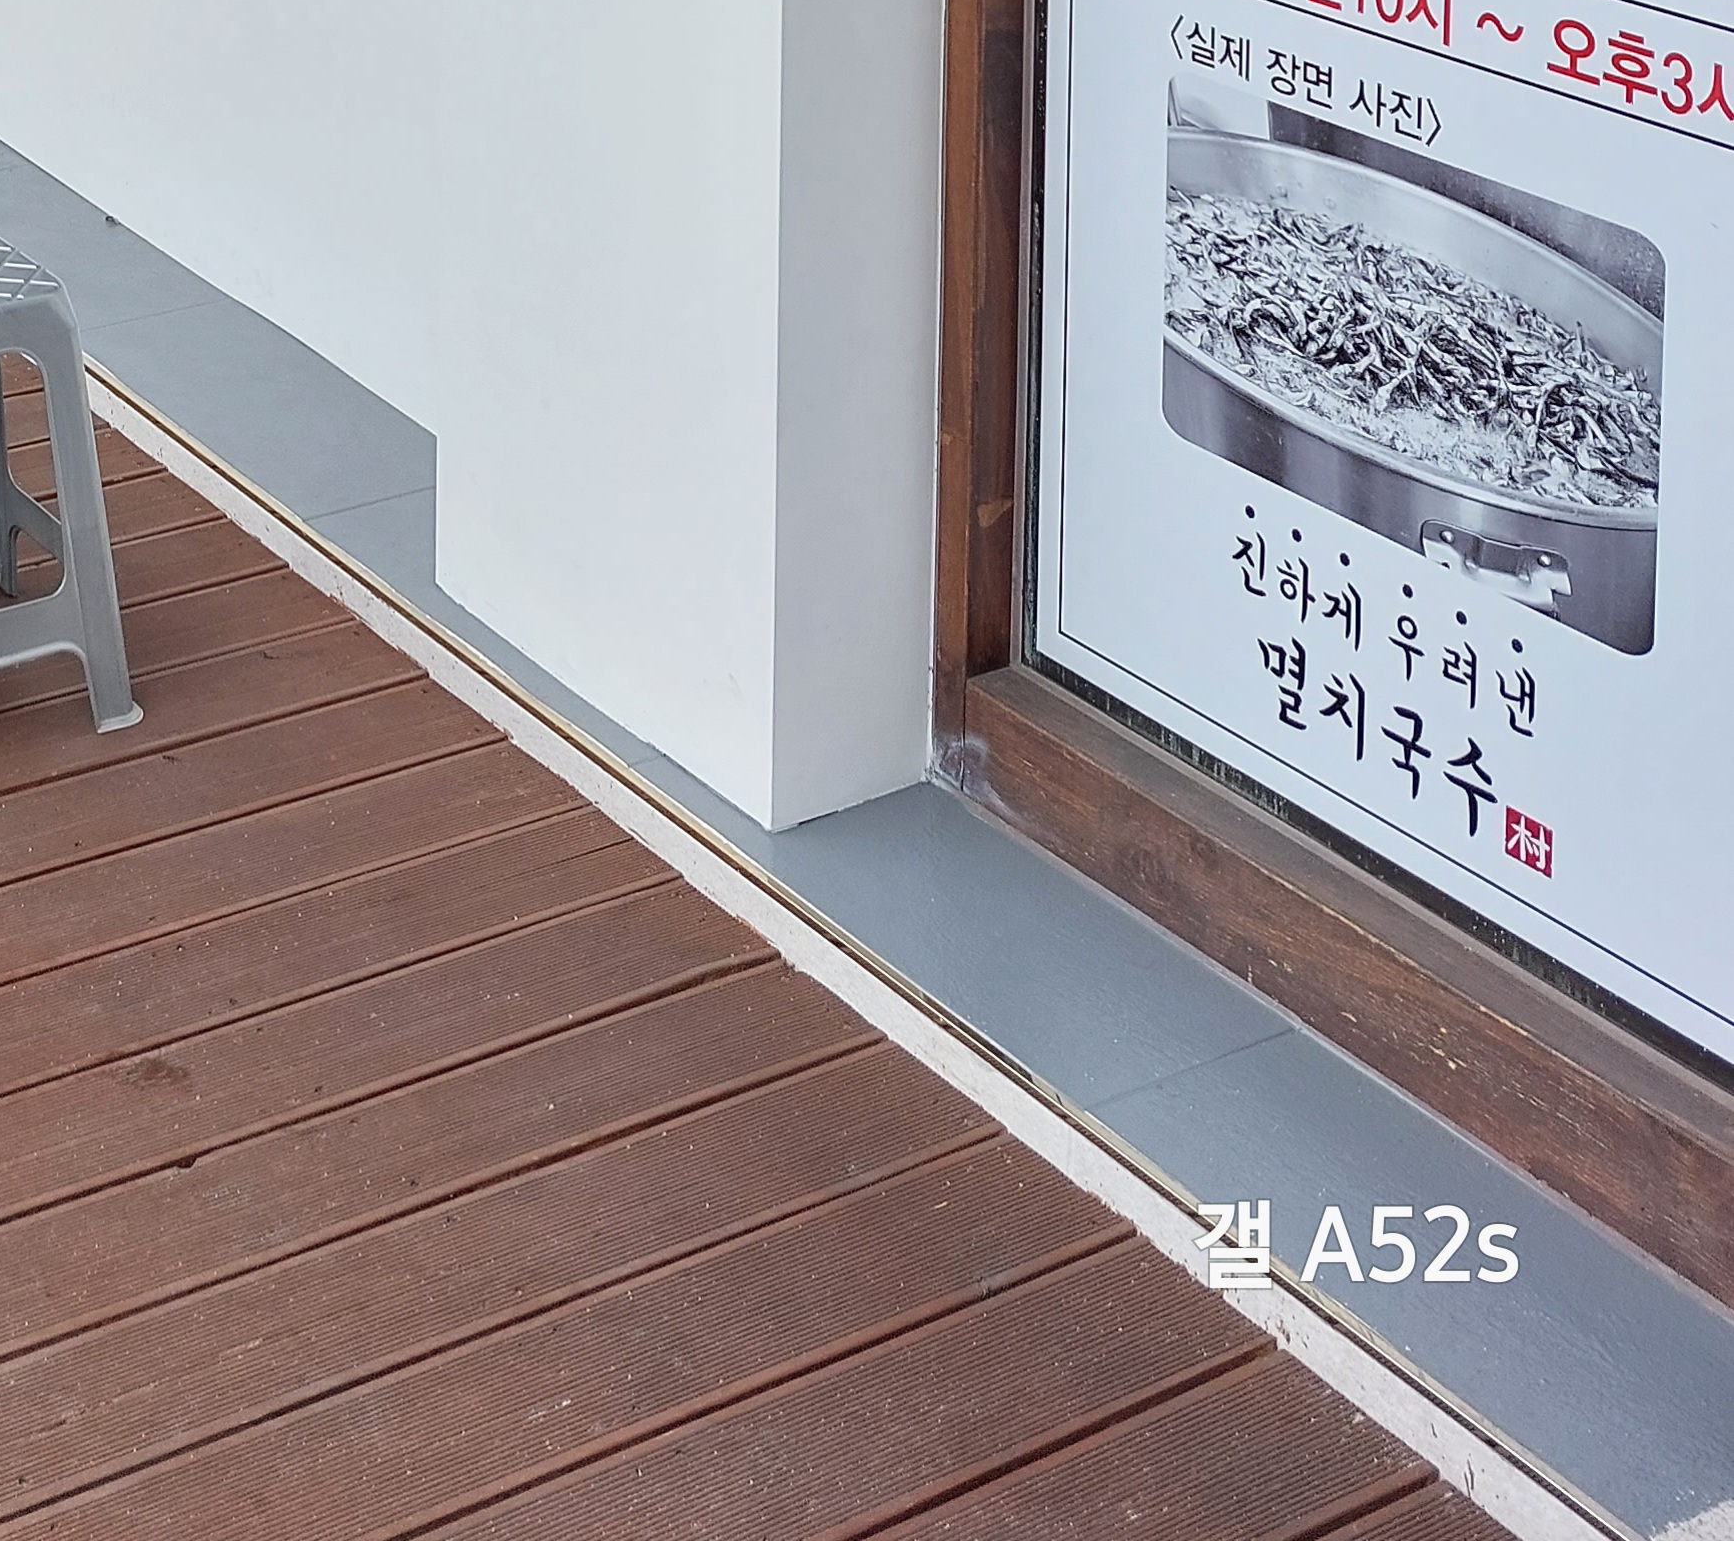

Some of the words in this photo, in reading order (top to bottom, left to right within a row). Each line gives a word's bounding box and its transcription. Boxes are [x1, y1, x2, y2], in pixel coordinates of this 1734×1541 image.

[1267, 46, 1334, 111] 장면
[1232, 531, 1362, 652] 진하게
[1388, 614, 1536, 737] 우려낸
[1257, 637, 1498, 837] 멸치국수
